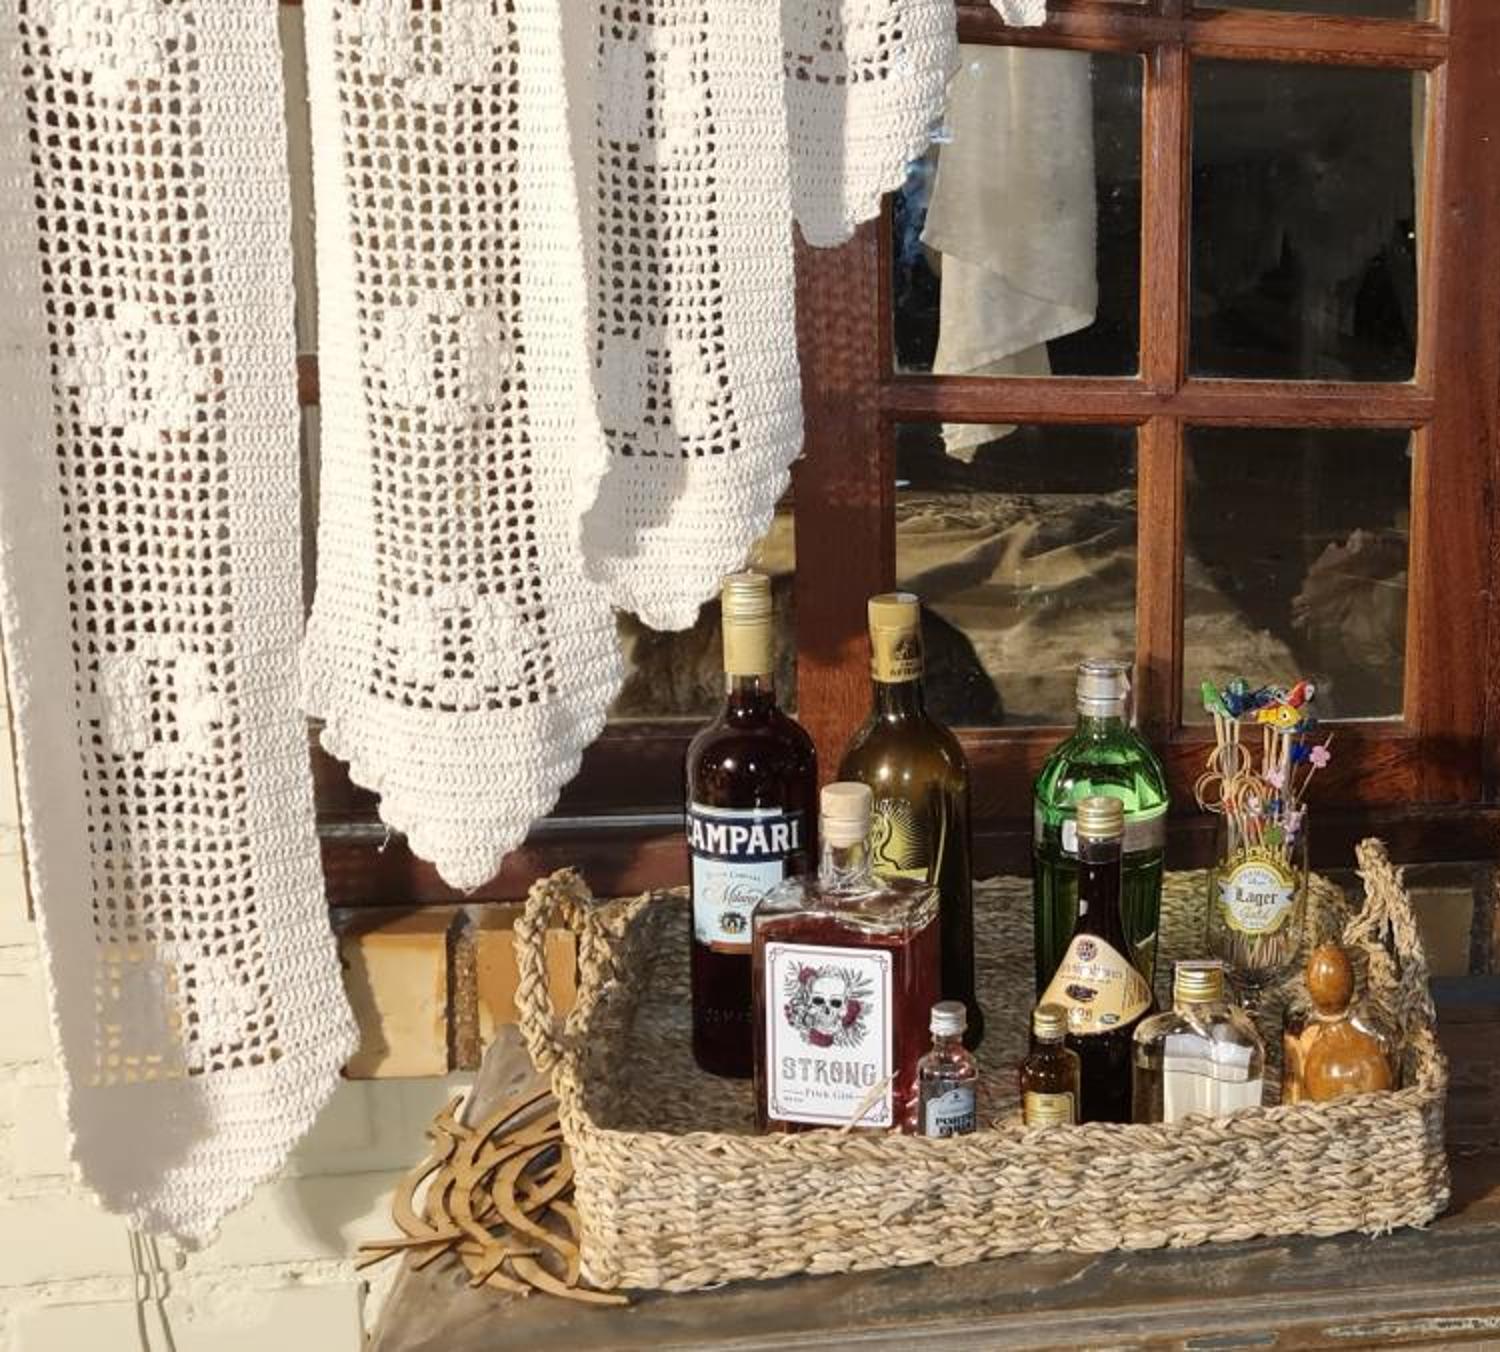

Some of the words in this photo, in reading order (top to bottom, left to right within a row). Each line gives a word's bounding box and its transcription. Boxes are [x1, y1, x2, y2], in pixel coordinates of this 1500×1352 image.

[687, 814, 799, 855] CAMPARI
[1235, 887, 1279, 907] Lager
[782, 1056, 877, 1088] STRONG
